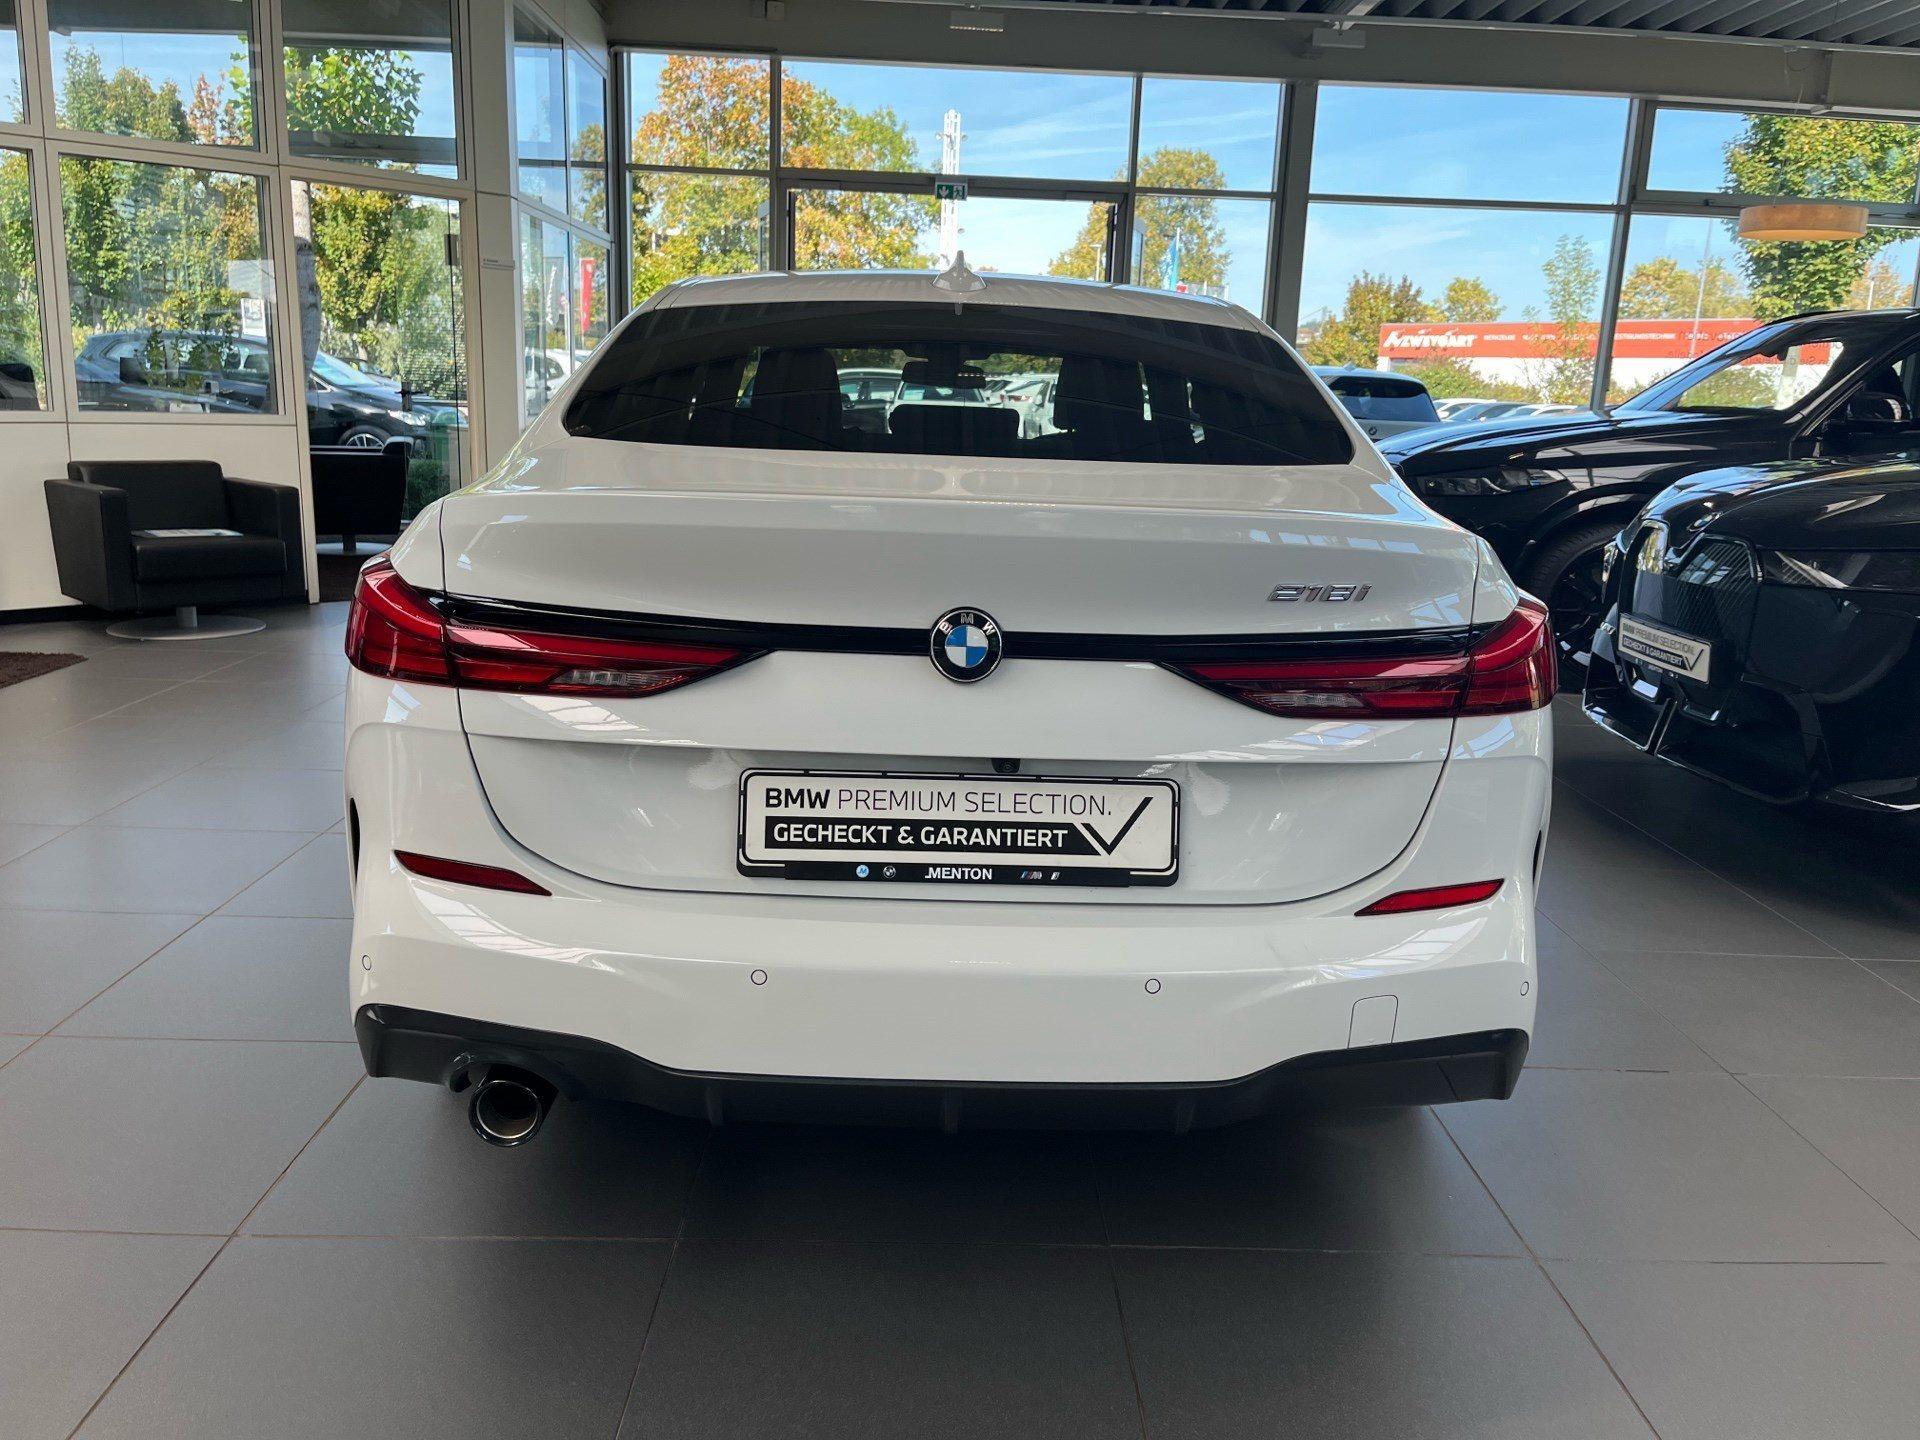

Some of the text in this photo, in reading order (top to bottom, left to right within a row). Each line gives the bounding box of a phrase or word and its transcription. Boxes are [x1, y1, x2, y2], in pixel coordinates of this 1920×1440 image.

[1267, 583, 1373, 602] 218i
[939, 612, 996, 636] BMW
[765, 788, 1112, 815] BMW PREMIUM SELECTION.
[773, 823, 1068, 848] GECHECKT & GARANTIERT
